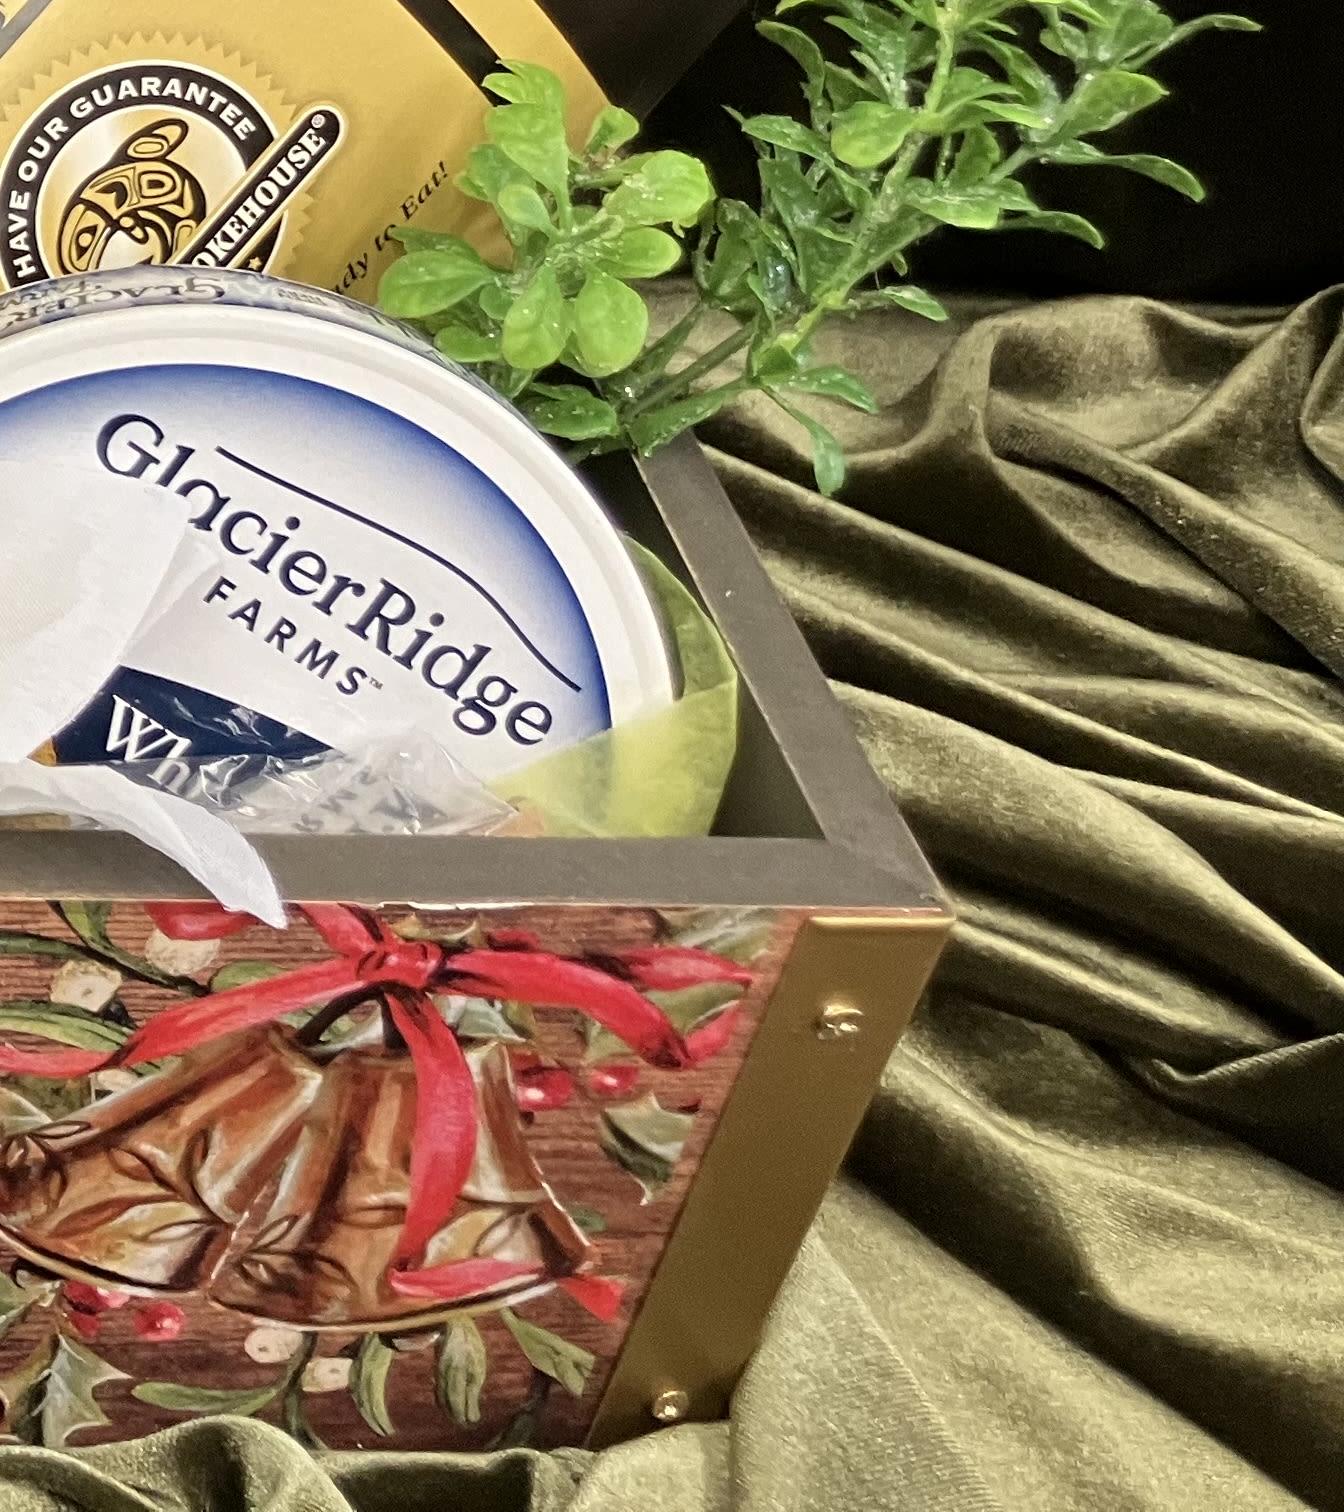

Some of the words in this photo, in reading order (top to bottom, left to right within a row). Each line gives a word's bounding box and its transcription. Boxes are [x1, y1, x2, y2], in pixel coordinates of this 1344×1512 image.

[69, 74, 257, 142] GUARANTEE
[17, 115, 68, 182] OUR
[399, 160, 448, 221] Eat!
[7, 190, 36, 278] HAVE
[95, 413, 554, 747] GlacierRidge
[103, 693, 199, 799] Wh
